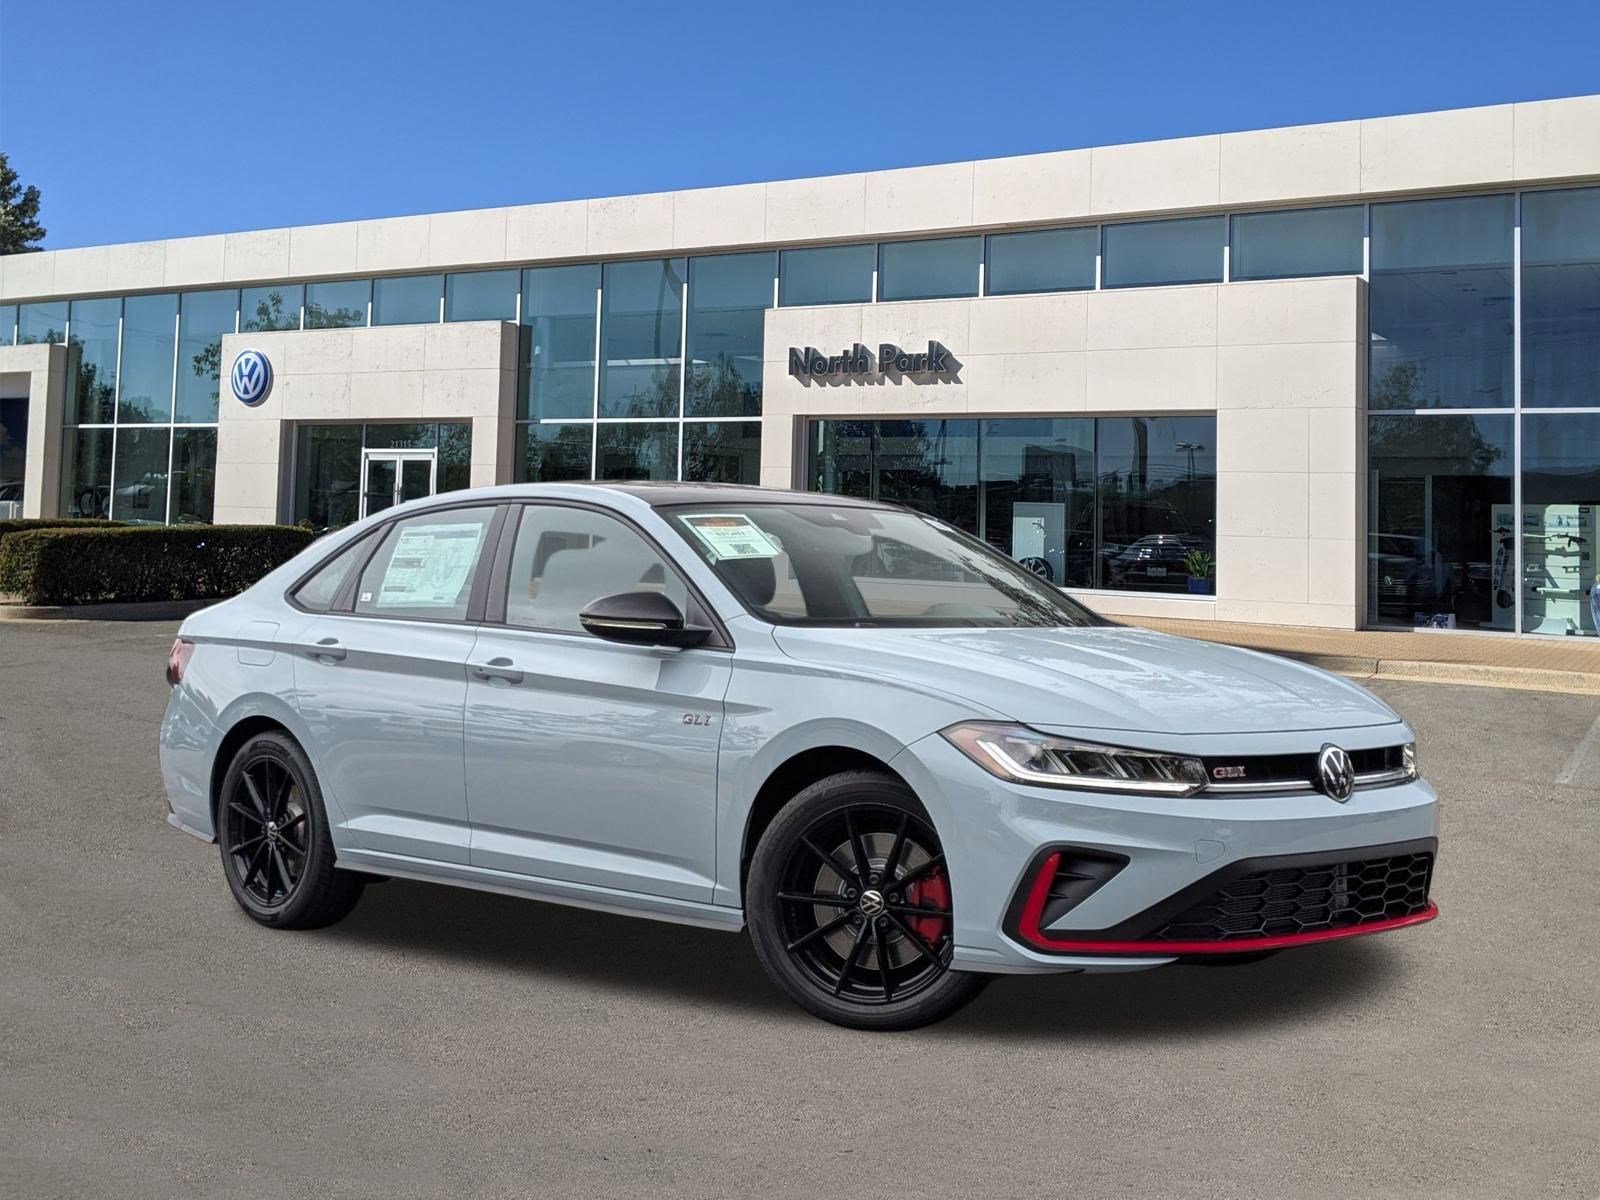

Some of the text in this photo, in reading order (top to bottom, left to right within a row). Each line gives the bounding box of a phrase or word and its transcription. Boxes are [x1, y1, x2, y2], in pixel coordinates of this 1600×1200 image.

[233, 352, 266, 400] VW
[788, 340, 948, 376] North Park
[682, 713, 712, 727] GLI
